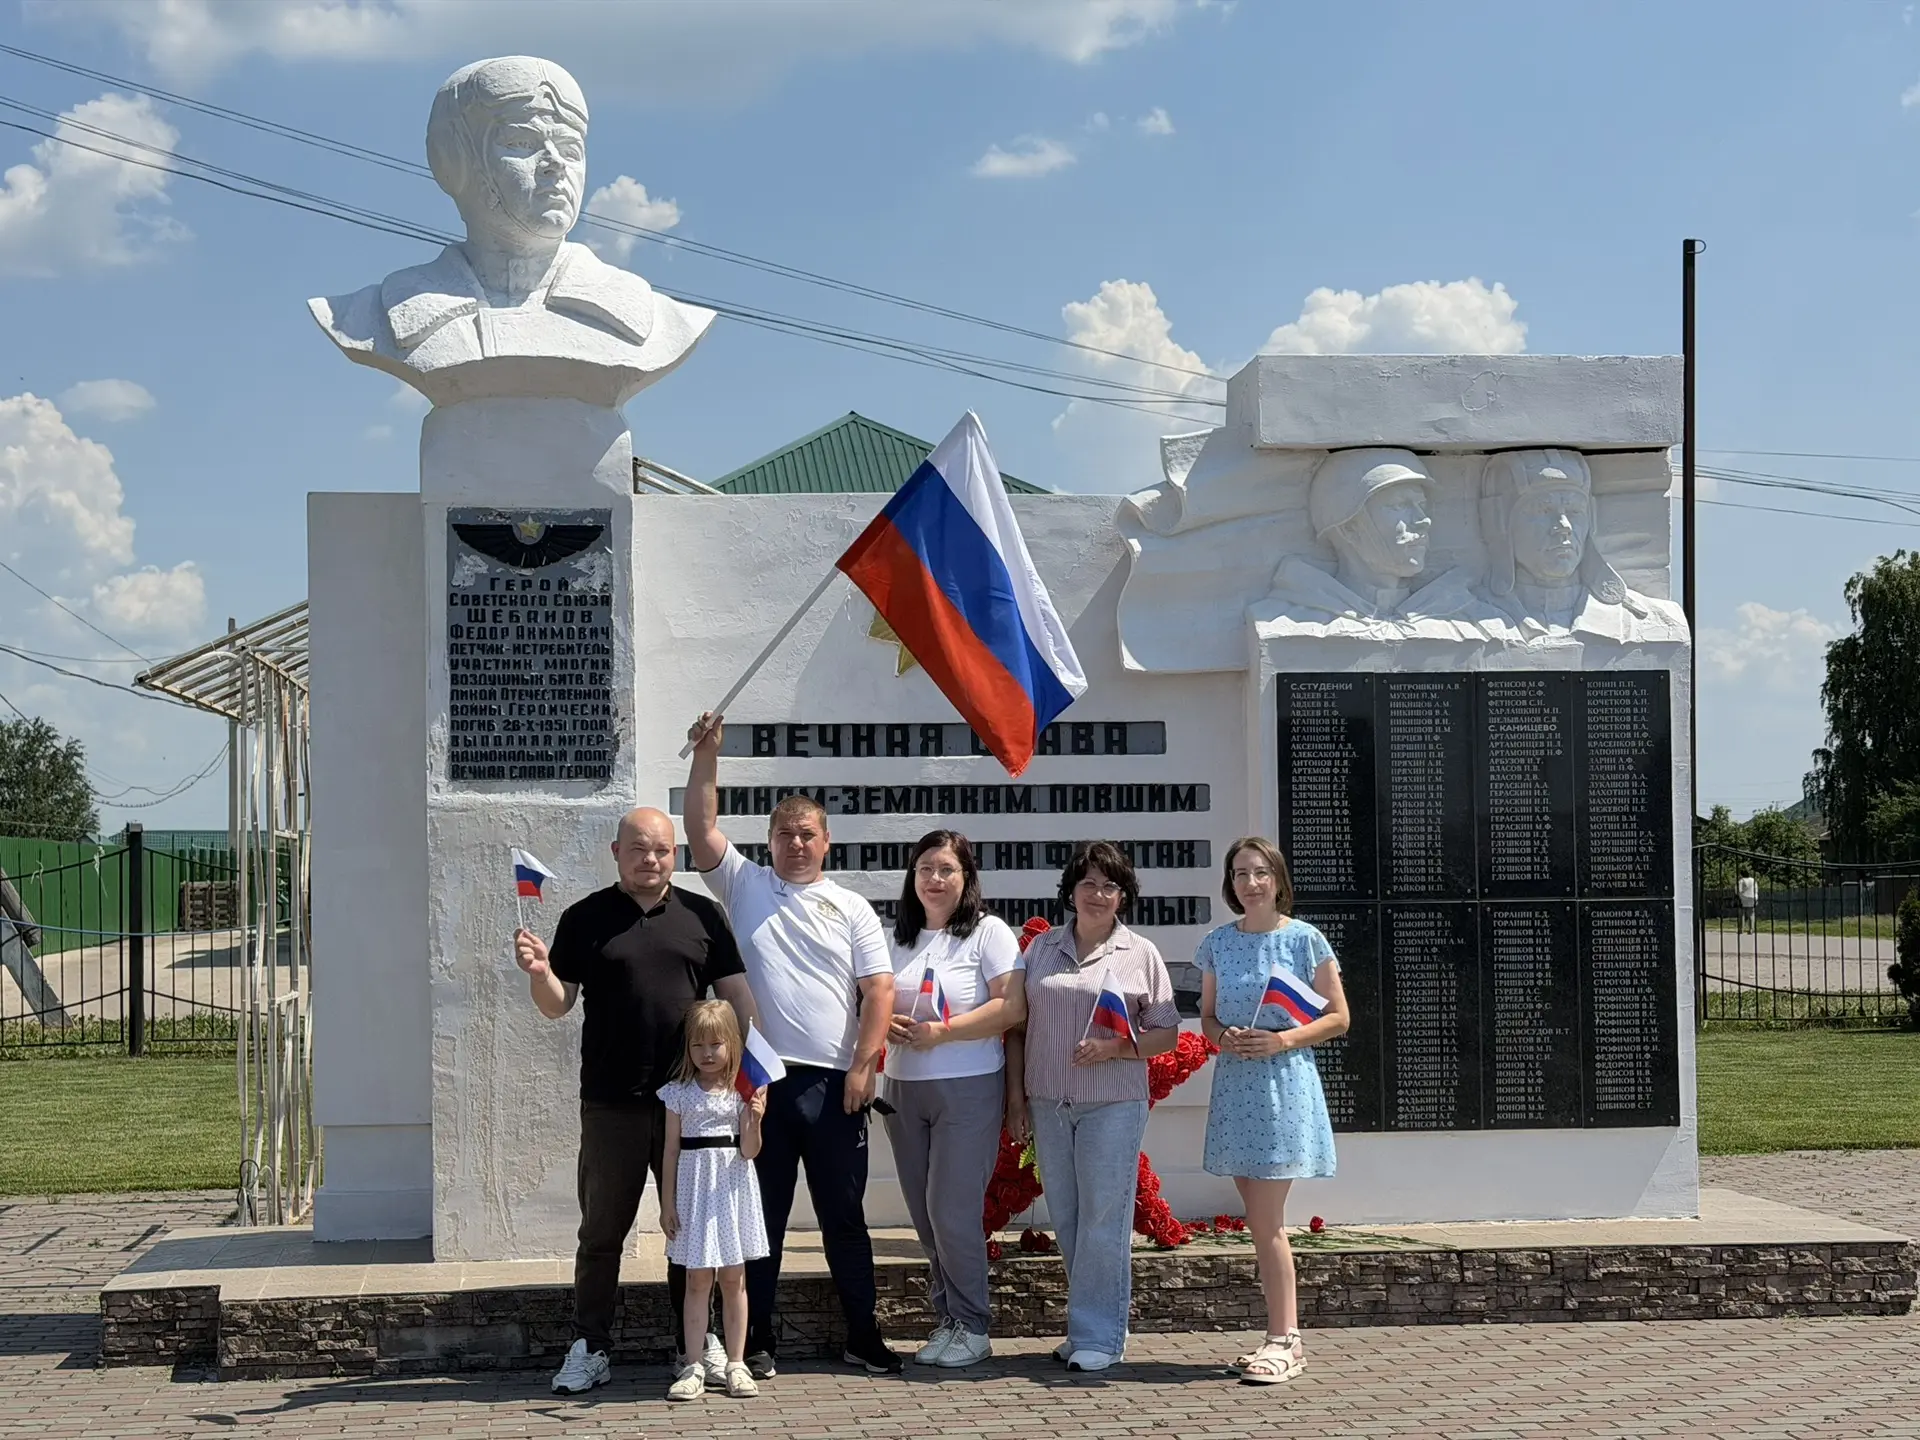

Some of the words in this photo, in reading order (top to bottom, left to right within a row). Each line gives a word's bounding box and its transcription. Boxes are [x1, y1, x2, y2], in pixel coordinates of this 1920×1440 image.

[490, 577, 569, 591] ГЕРОЙ
[467, 608, 593, 623] ШЕБАНОВ
[450, 658, 532, 670] УЧАСТНИК
[544, 658, 610, 670] МНОГИХ
[550, 673, 584, 686] БИТВ
[1291, 683, 1352, 691] С.СТУДЕНКИ
[450, 719, 496, 732] ПОГИБ
[1500, 725, 1557, 733] КАНИЩЕВО
[450, 735, 552, 747] ВЫПОЛНЯЯ
[752, 724, 944, 757] ВЕЧНАЯ
[971, 723, 1127, 755] САВА
[509, 765, 555, 779] СЛАВА
[1050, 785, 1197, 814] ПАВШИМ
[996, 842, 1034, 870] НА
